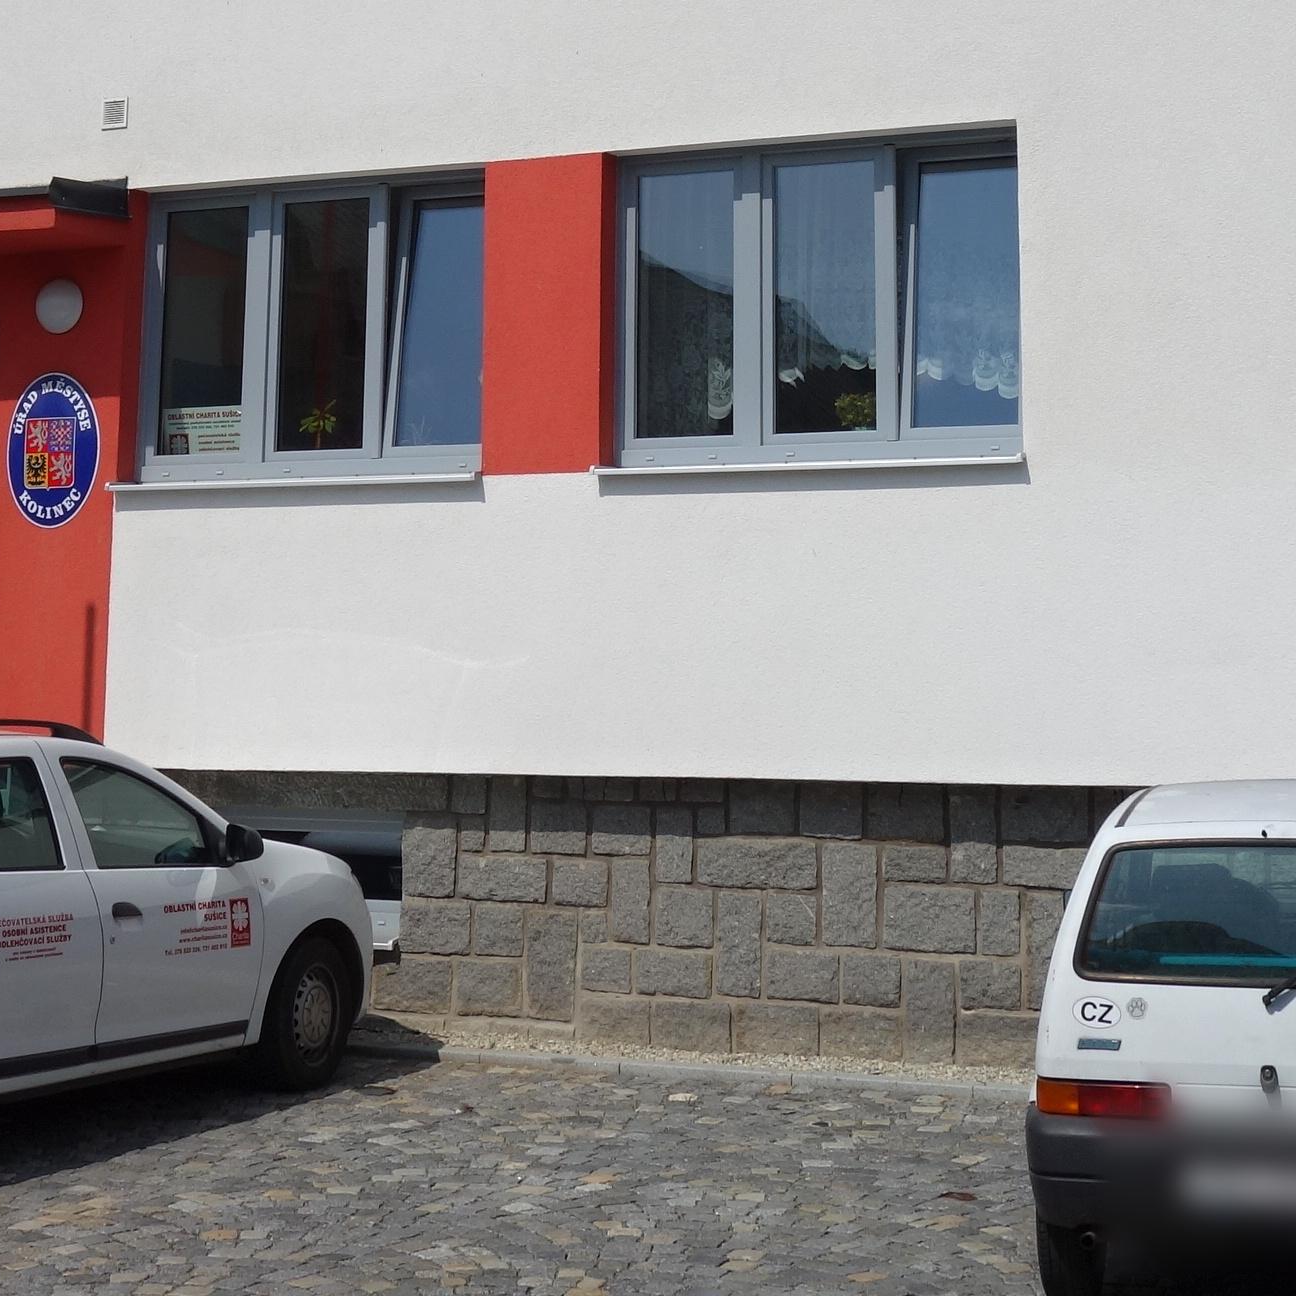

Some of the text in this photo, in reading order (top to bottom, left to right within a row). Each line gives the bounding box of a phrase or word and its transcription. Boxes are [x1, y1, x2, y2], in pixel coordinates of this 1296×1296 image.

[13, 390, 39, 435] ÚŘAD
[196, 410, 221, 419] CHARITA
[18, 488, 82, 520] KOLINEC
[164, 900, 226, 913] OBLASTNÍ CHARITA
[48, 912, 74, 923] SLUŽBA
[204, 911, 227, 921] SUŠICE
[2, 924, 67, 938] OSOBNÍ ASISTENCE
[46, 933, 72, 944] SLUŽBY
[1081, 1002, 1114, 1024] CZ
